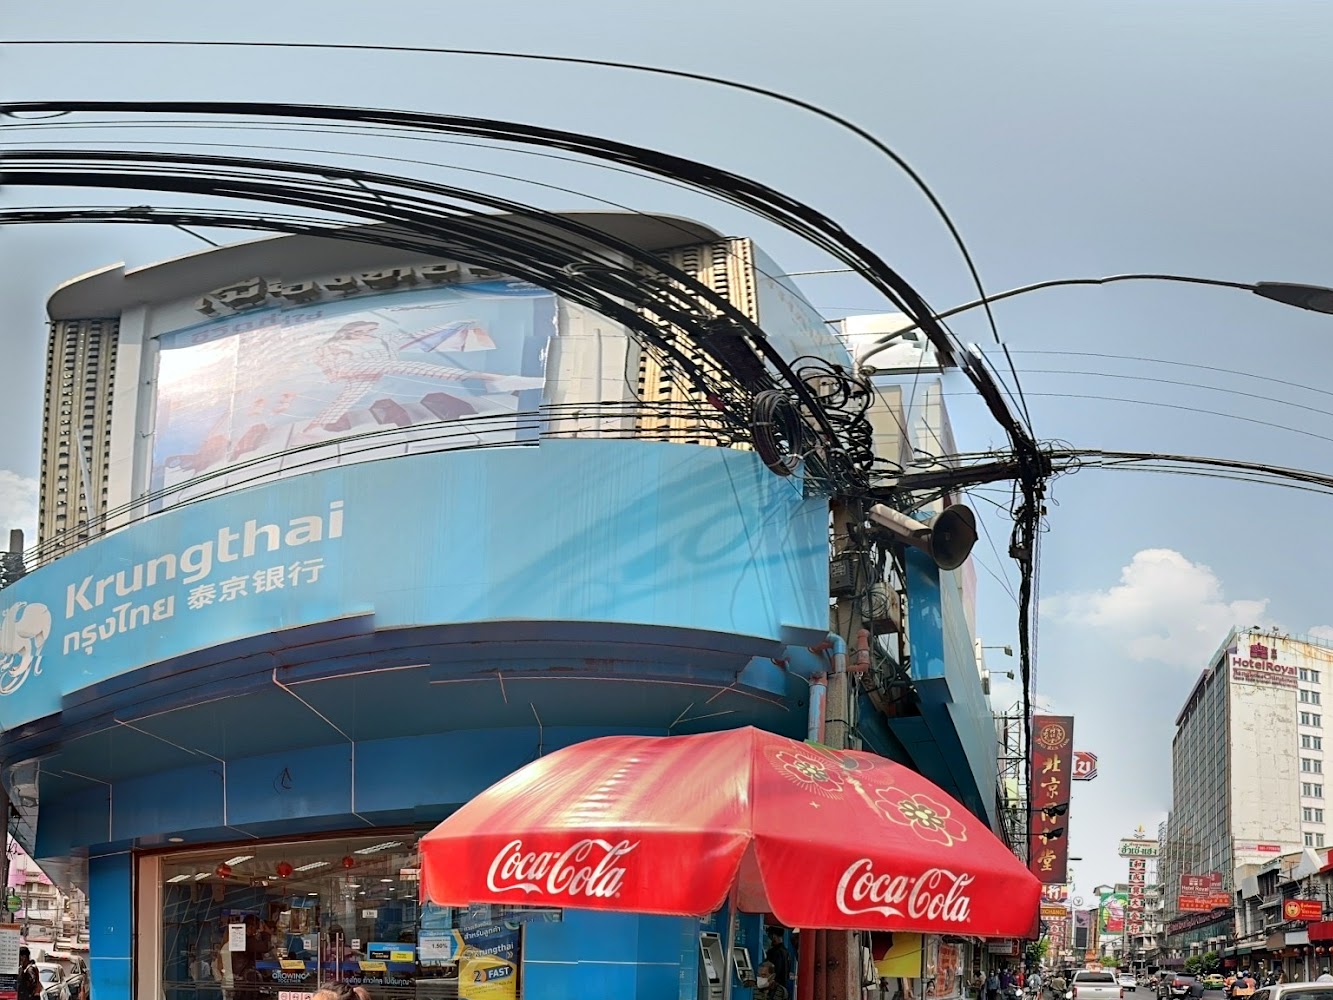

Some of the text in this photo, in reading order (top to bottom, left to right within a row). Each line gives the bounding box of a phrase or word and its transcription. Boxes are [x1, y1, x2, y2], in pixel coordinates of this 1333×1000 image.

[64, 500, 345, 619] Krungthai
[187, 557, 326, 611] 泰京银行
[62, 595, 176, 656] กรุงไทย
[1233, 657, 1298, 675] Hotel Royal
[486, 837, 641, 899] Coca-Cola
[835, 857, 977, 923] Coca-Cola
[488, 966, 510, 979] FAST
